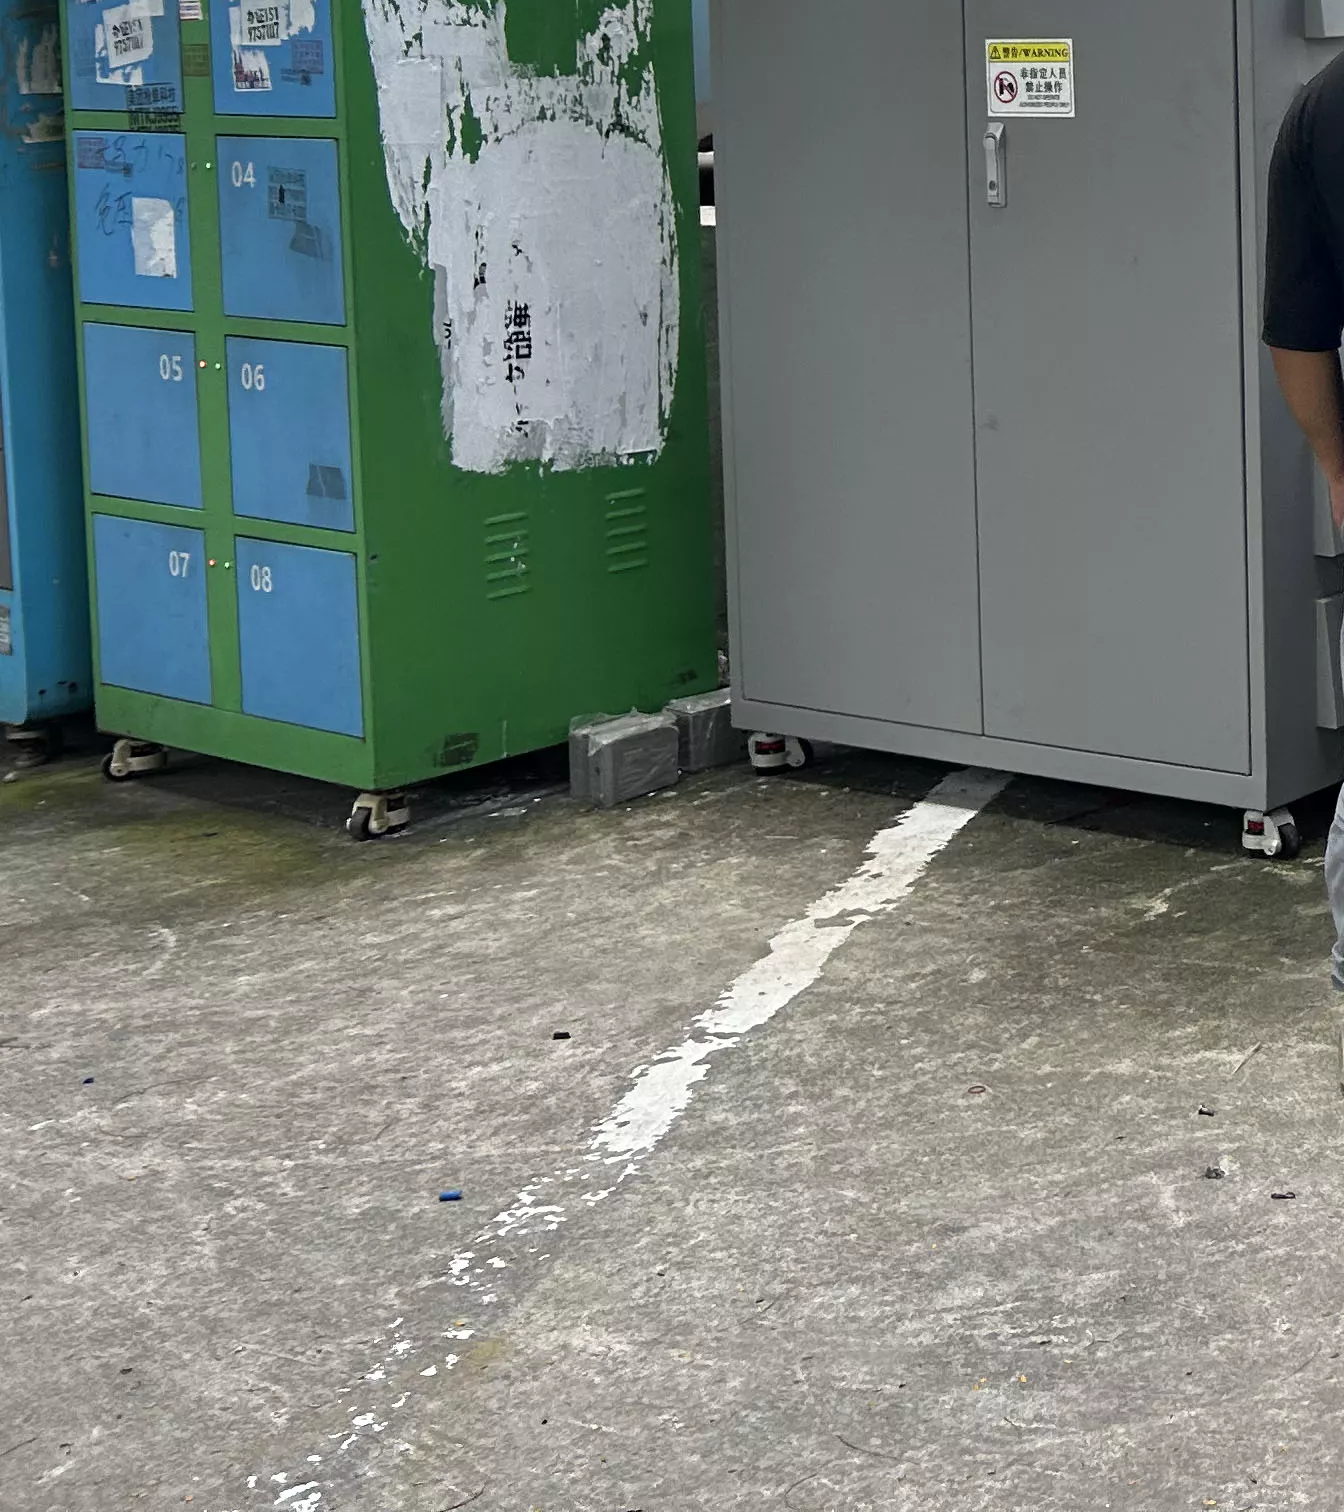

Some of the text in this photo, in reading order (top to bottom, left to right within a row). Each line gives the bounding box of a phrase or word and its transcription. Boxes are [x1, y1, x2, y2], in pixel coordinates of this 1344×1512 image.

[1020, 67, 1067, 79] 非指定人员
[231, 160, 256, 188] 04
[159, 353, 182, 382] 05
[241, 363, 265, 391] 06
[169, 550, 190, 578] 07
[250, 564, 272, 593] 08
